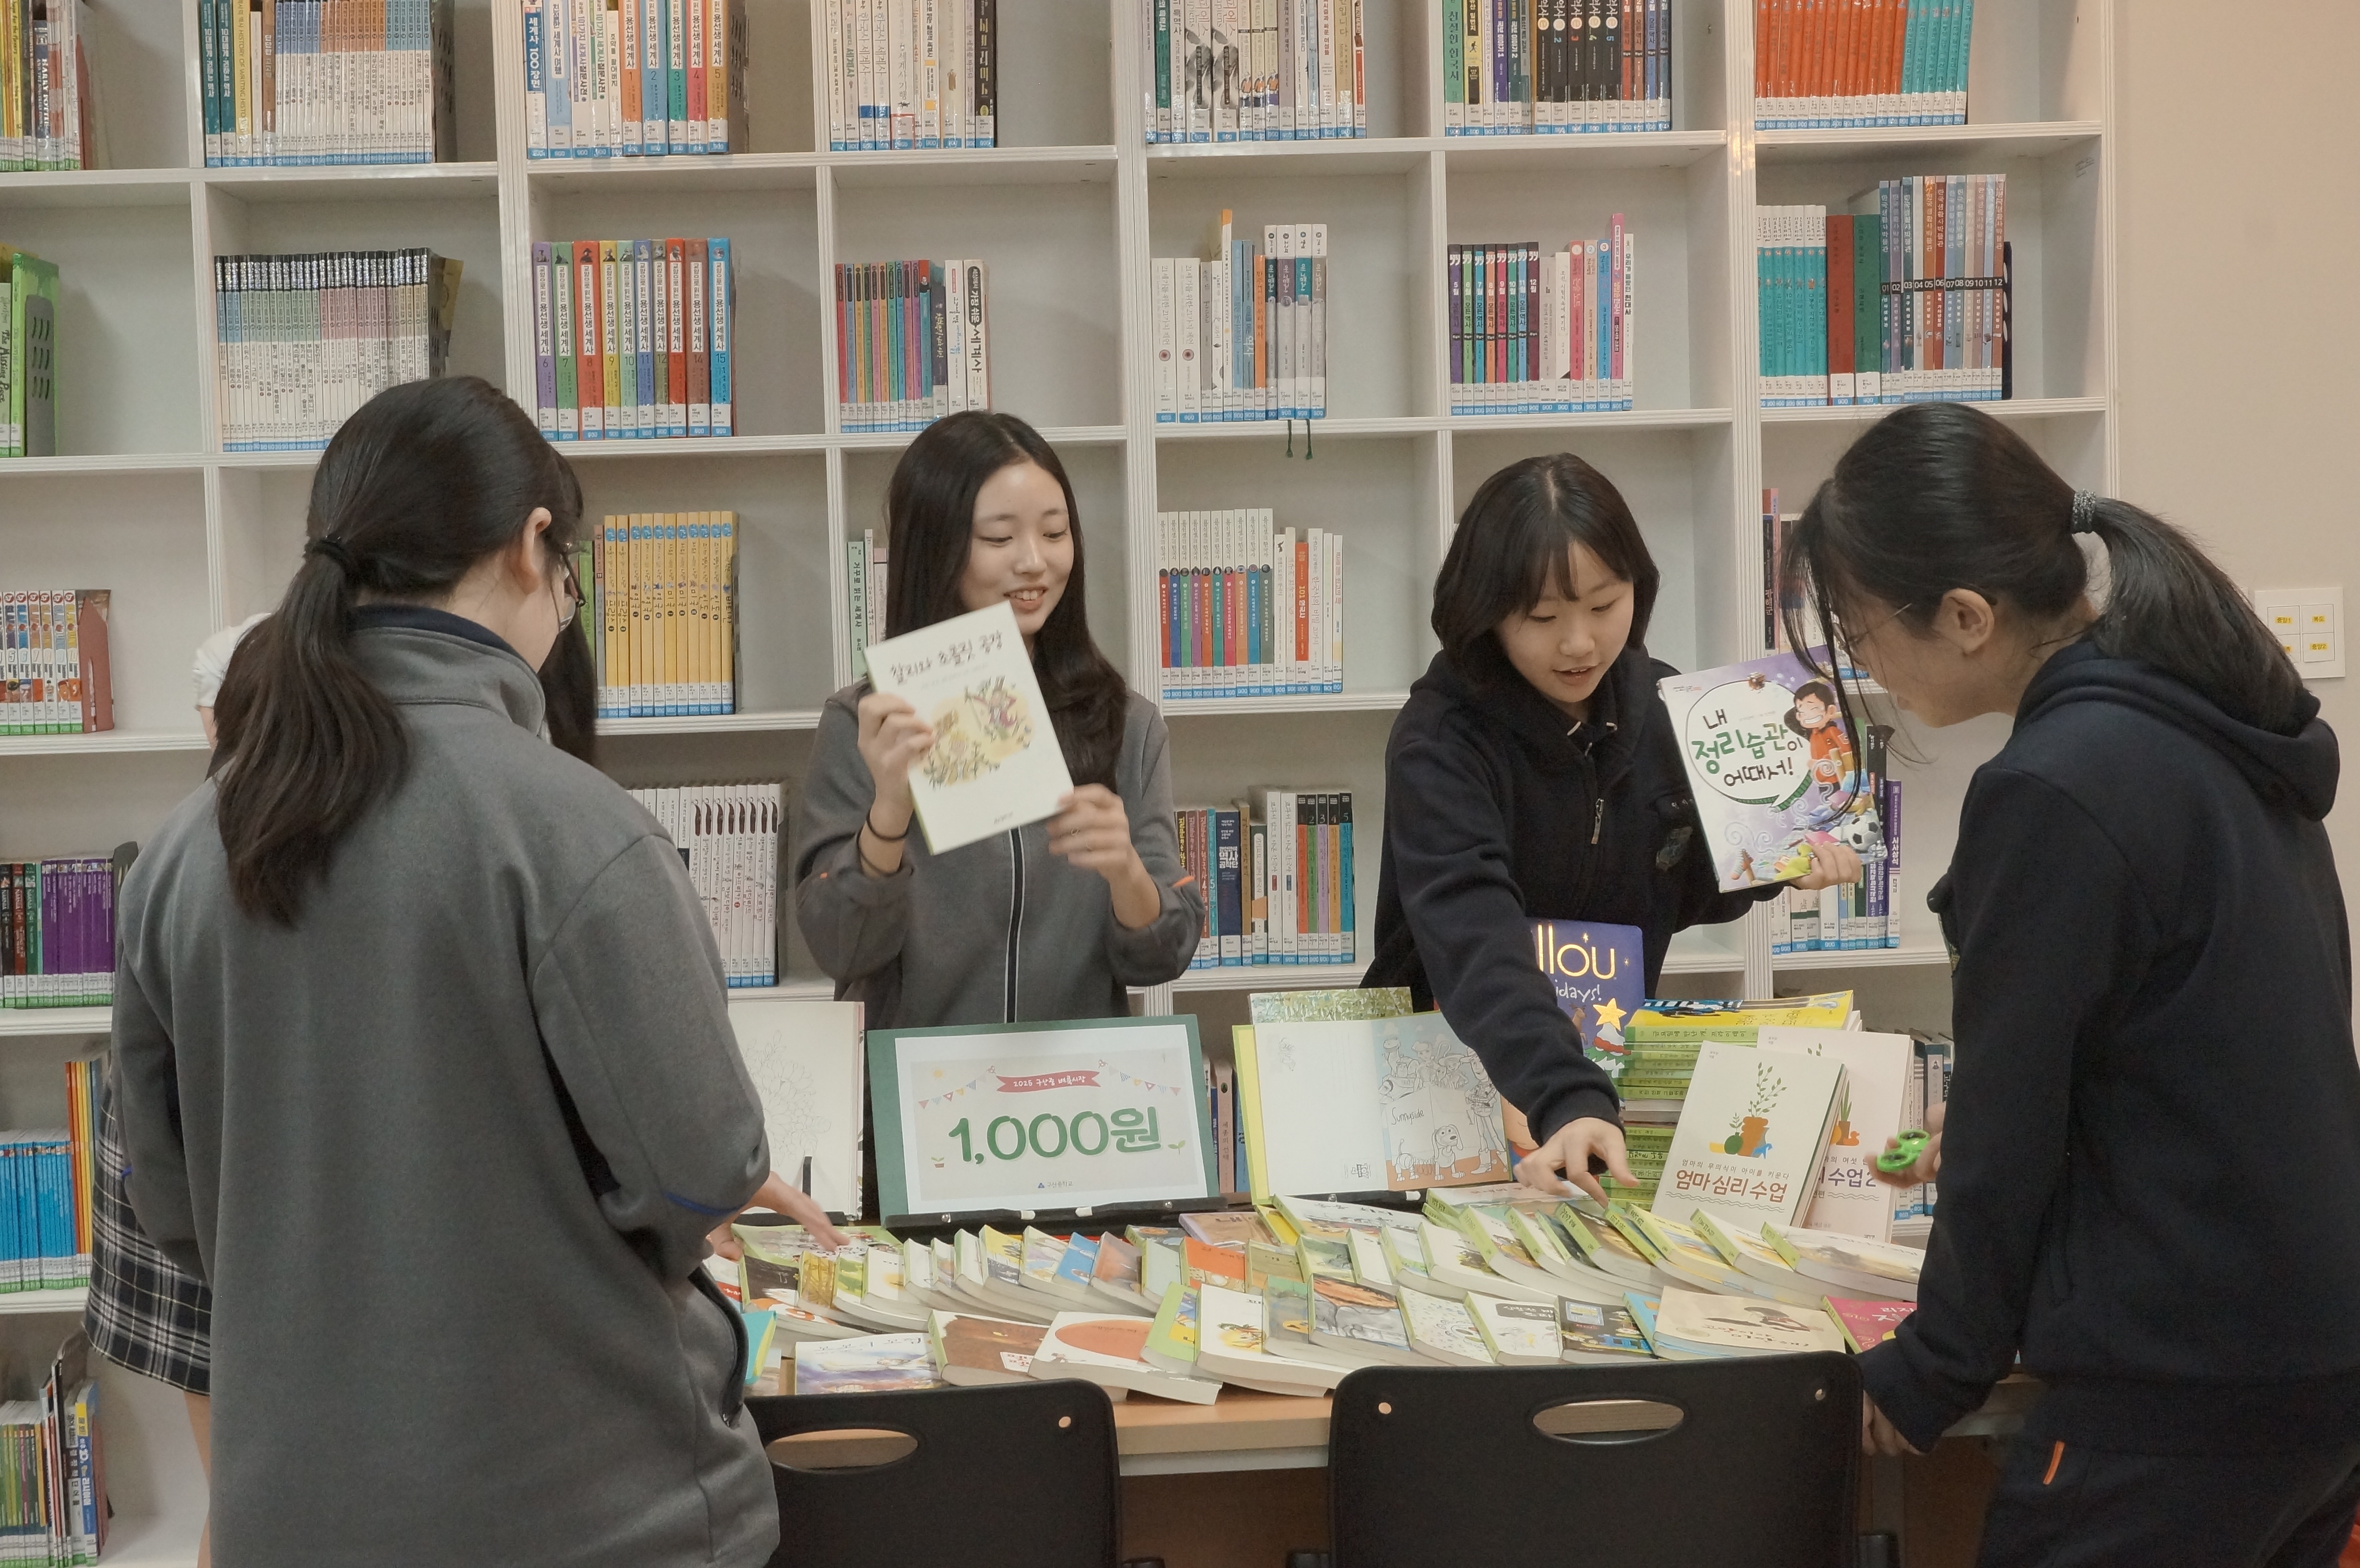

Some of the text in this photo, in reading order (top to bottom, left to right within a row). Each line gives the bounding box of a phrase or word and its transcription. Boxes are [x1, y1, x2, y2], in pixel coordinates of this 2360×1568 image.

[529, 17, 541, 88] 세계사 100 장면
[626, 16, 635, 81] 용선생 세계사 1
[649, 16, 657, 81] 용선생 세계사 2
[673, 44, 681, 69] 세계사
[692, 43, 701, 67] 세계사
[713, 41, 722, 66] 세계사
[859, 46, 871, 75] 세계사
[875, 46, 887, 75] 세계사
[555, 59, 562, 74] 여행
[674, 71, 680, 81] 3
[694, 69, 699, 79] 4
[714, 68, 720, 79] 5
[540, 290, 546, 302] 읽는
[560, 290, 566, 302] 읽는
[640, 286, 646, 298] 읽는
[716, 286, 722, 298] 읽는
[539, 303, 548, 328] 용선생
[559, 303, 568, 329] 용선생
[639, 300, 648, 325] 용선생
[715, 299, 724, 324] 용선생
[970, 290, 979, 323] 가장 쉬운
[584, 289, 593, 355] 읽는 용선생 세계사
[606, 288, 615, 366] 읽는 용선생 세계사 9
[624, 288, 634, 366] 읽는 용선생 세계사 10
[656, 287, 666, 364] 읽는 용선생 세계사 12
[672, 287, 681, 352] 읽는 용선생 세계사
[693, 287, 702, 351] 읽는 용선생 세계사
[540, 330, 549, 355] 세계사
[560, 331, 569, 355] 세계사
[640, 327, 649, 351] 세계사
[716, 326, 725, 351] 세계사
[971, 325, 982, 373] 세계사
[542, 358, 549, 368] 6
[563, 358, 568, 368] 7
[641, 355, 650, 364] 11
[716, 353, 726, 364] 15
[606, 600, 615, 624] 프랑스
[618, 600, 627, 624] 프랑스
[1703, 708, 1728, 729] 내
[1691, 721, 1804, 774] 정리습관이
[1723, 757, 1793, 787] 어때서!
[1319, 814, 1326, 823] 3
[1331, 815, 1336, 823] 4
[1343, 813, 1349, 821] 5
[1219, 852, 1239, 862] 역사
[1202, 880, 1207, 890] 4
[1209, 879, 1215, 889] 5
[1537, 923, 1616, 980] llou
[1554, 978, 1603, 1003] idays!
[1036, 1077, 1056, 1087] 구산중
[1057, 1075, 1086, 1086] 벼룩시장
[1390, 1106, 1426, 1126] Sunnyside
[948, 1105, 1162, 1165] 1,000원
[1682, 1159, 1790, 1181] 엄마의 무의식이 아이를 키운다
[1842, 1155, 1857, 1164] 여섯
[1046, 1180, 1073, 1189] 구산중학교
[1676, 1169, 1711, 1191] 엄마
[1712, 1175, 1749, 1196] 심리
[1749, 1180, 1788, 1203] 수업
